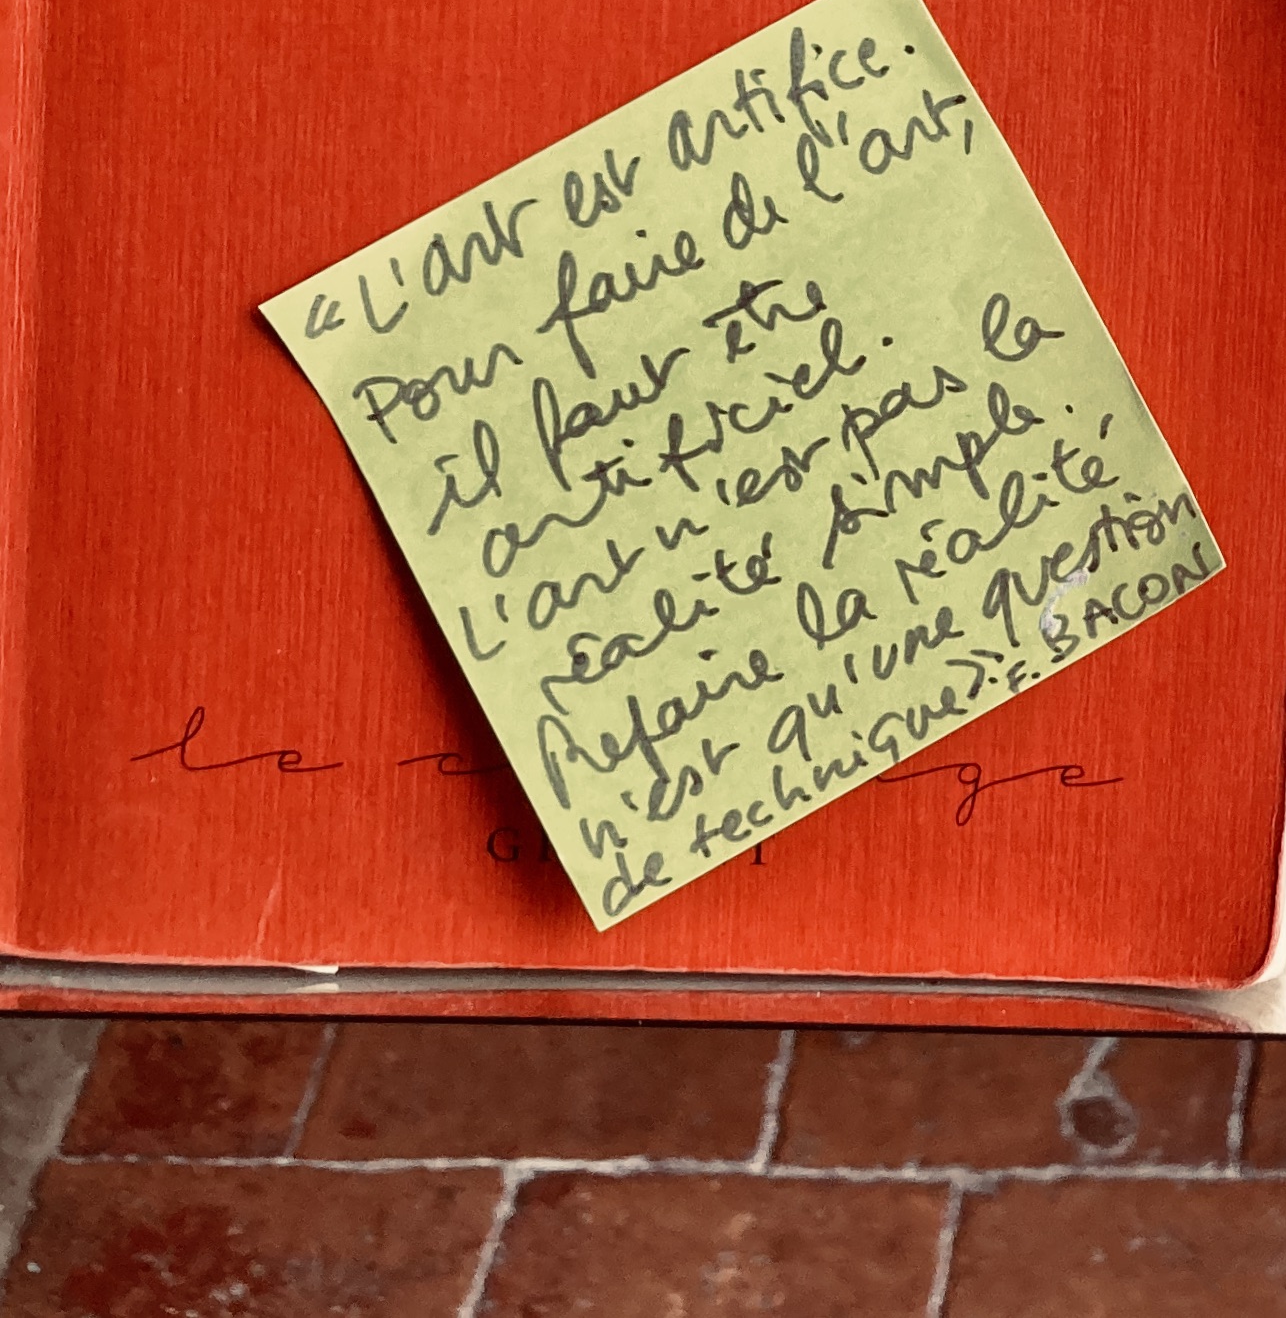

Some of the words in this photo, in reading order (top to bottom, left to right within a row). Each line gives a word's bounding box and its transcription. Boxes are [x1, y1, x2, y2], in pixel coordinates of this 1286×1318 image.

[563, 149, 640, 228] est
[535, 230, 705, 377] faire
[722, 172, 789, 252] de
[425, 420, 500, 535] il
[534, 348, 690, 465] faut
[702, 276, 827, 362] être
[840, 362, 968, 476] pas
[980, 291, 1065, 362] la
[798, 582, 879, 651] la
[599, 853, 674, 919] de
